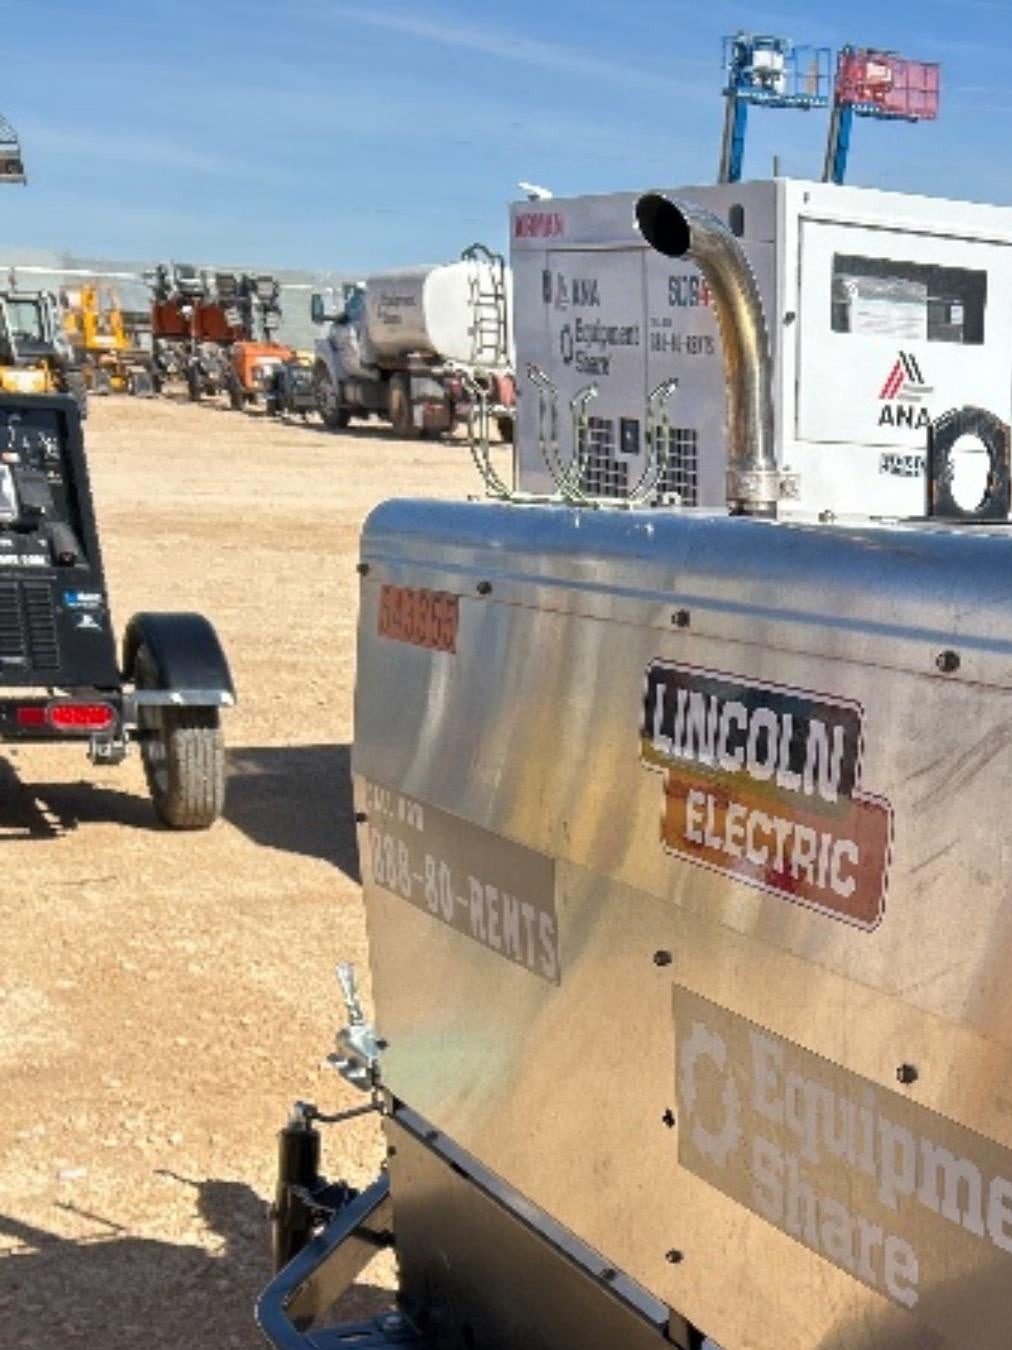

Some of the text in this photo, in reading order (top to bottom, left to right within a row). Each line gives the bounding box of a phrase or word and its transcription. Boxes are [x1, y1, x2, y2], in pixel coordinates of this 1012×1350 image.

[575, 318, 640, 348] Equipment
[878, 404, 931, 430] ANA
[653, 682, 845, 804] LINCOLN
[685, 788, 860, 898] ELECTRIC
[369, 825, 559, 980] 888-80-RENTS
[750, 1135, 920, 1309] Share
